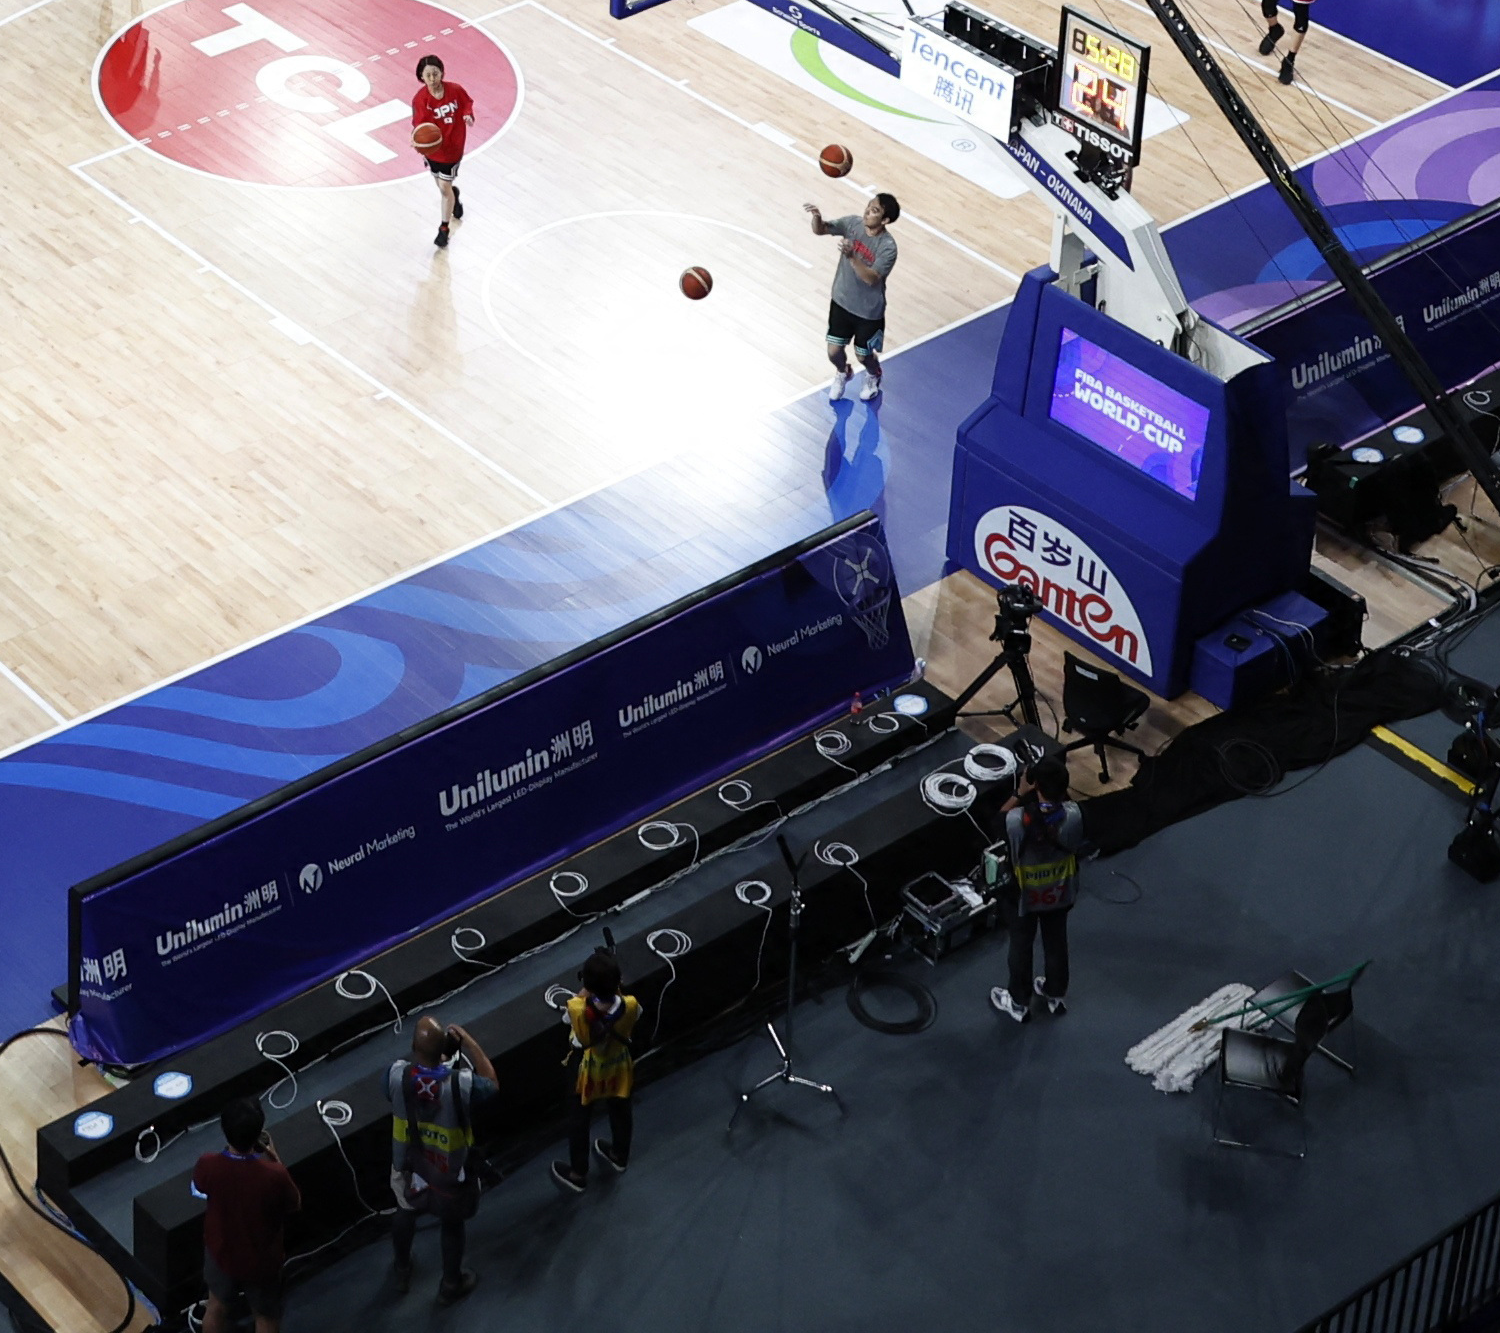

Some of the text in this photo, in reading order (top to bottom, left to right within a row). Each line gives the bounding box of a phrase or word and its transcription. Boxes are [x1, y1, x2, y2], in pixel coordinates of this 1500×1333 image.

[189, 1, 418, 166] TCL
[907, 28, 1008, 101] Tencent
[432, 99, 460, 121] JPN
[933, 74, 974, 117] 腾讯
[1076, 121, 1134, 164] TISSOT
[1047, 174, 1095, 226] OKINAWA
[1075, 368, 1187, 442] FIBA BASKETBALL
[1075, 380, 1183, 454] WORLD CUP
[1006, 509, 1109, 595] 百岁山
[767, 614, 842, 656] Neural Marketing
[619, 681, 695, 727] Unilumin
[551, 720, 595, 765] 洲明
[439, 749, 549, 819] Unilumin
[328, 826, 415, 874] Neural Marketing
[444, 821, 458, 833] The
[244, 880, 280, 915] 洲明
[157, 903, 244, 958] Unilumin
